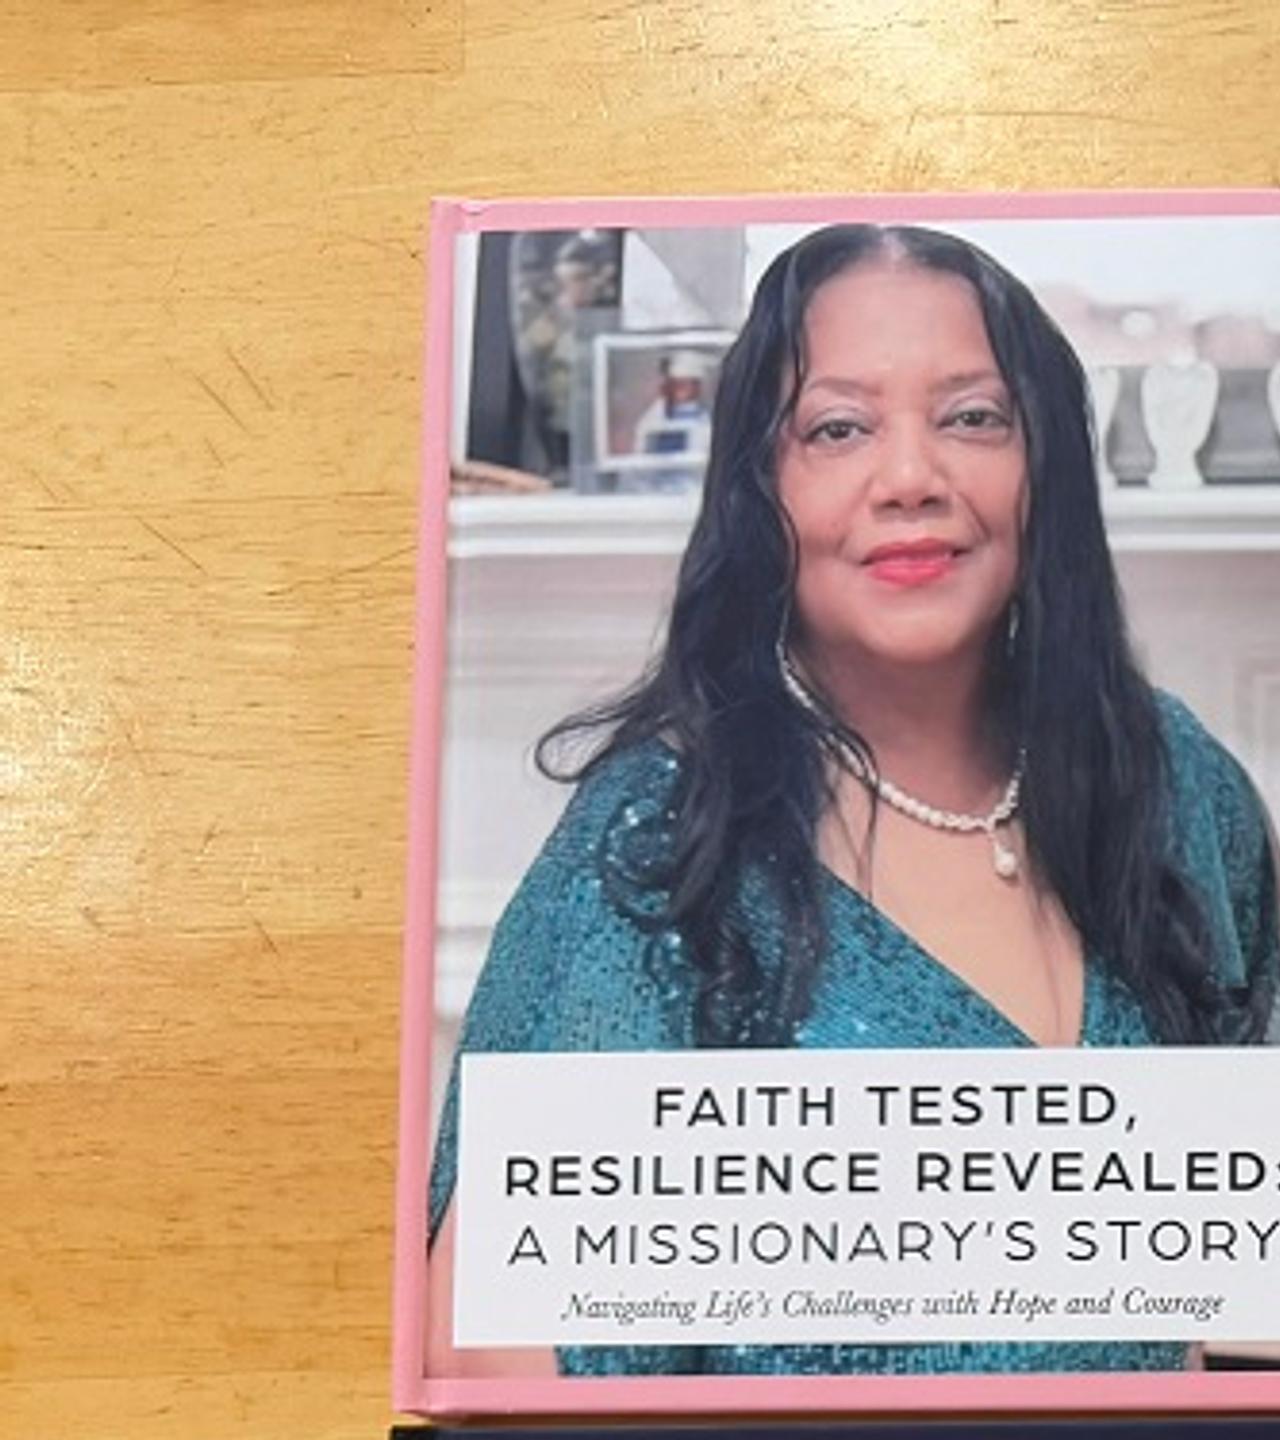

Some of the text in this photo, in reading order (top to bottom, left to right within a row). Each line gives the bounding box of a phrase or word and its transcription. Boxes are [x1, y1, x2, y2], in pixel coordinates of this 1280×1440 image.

[656, 1086, 1135, 1131] FAITH TESTED,
[507, 1153, 879, 1196] RESILIENCE
[508, 1221, 1280, 1264] A MISSIONARY'S STORY
[563, 1288, 1224, 1323] Navigating Life's Challenges with Hope and Courage
